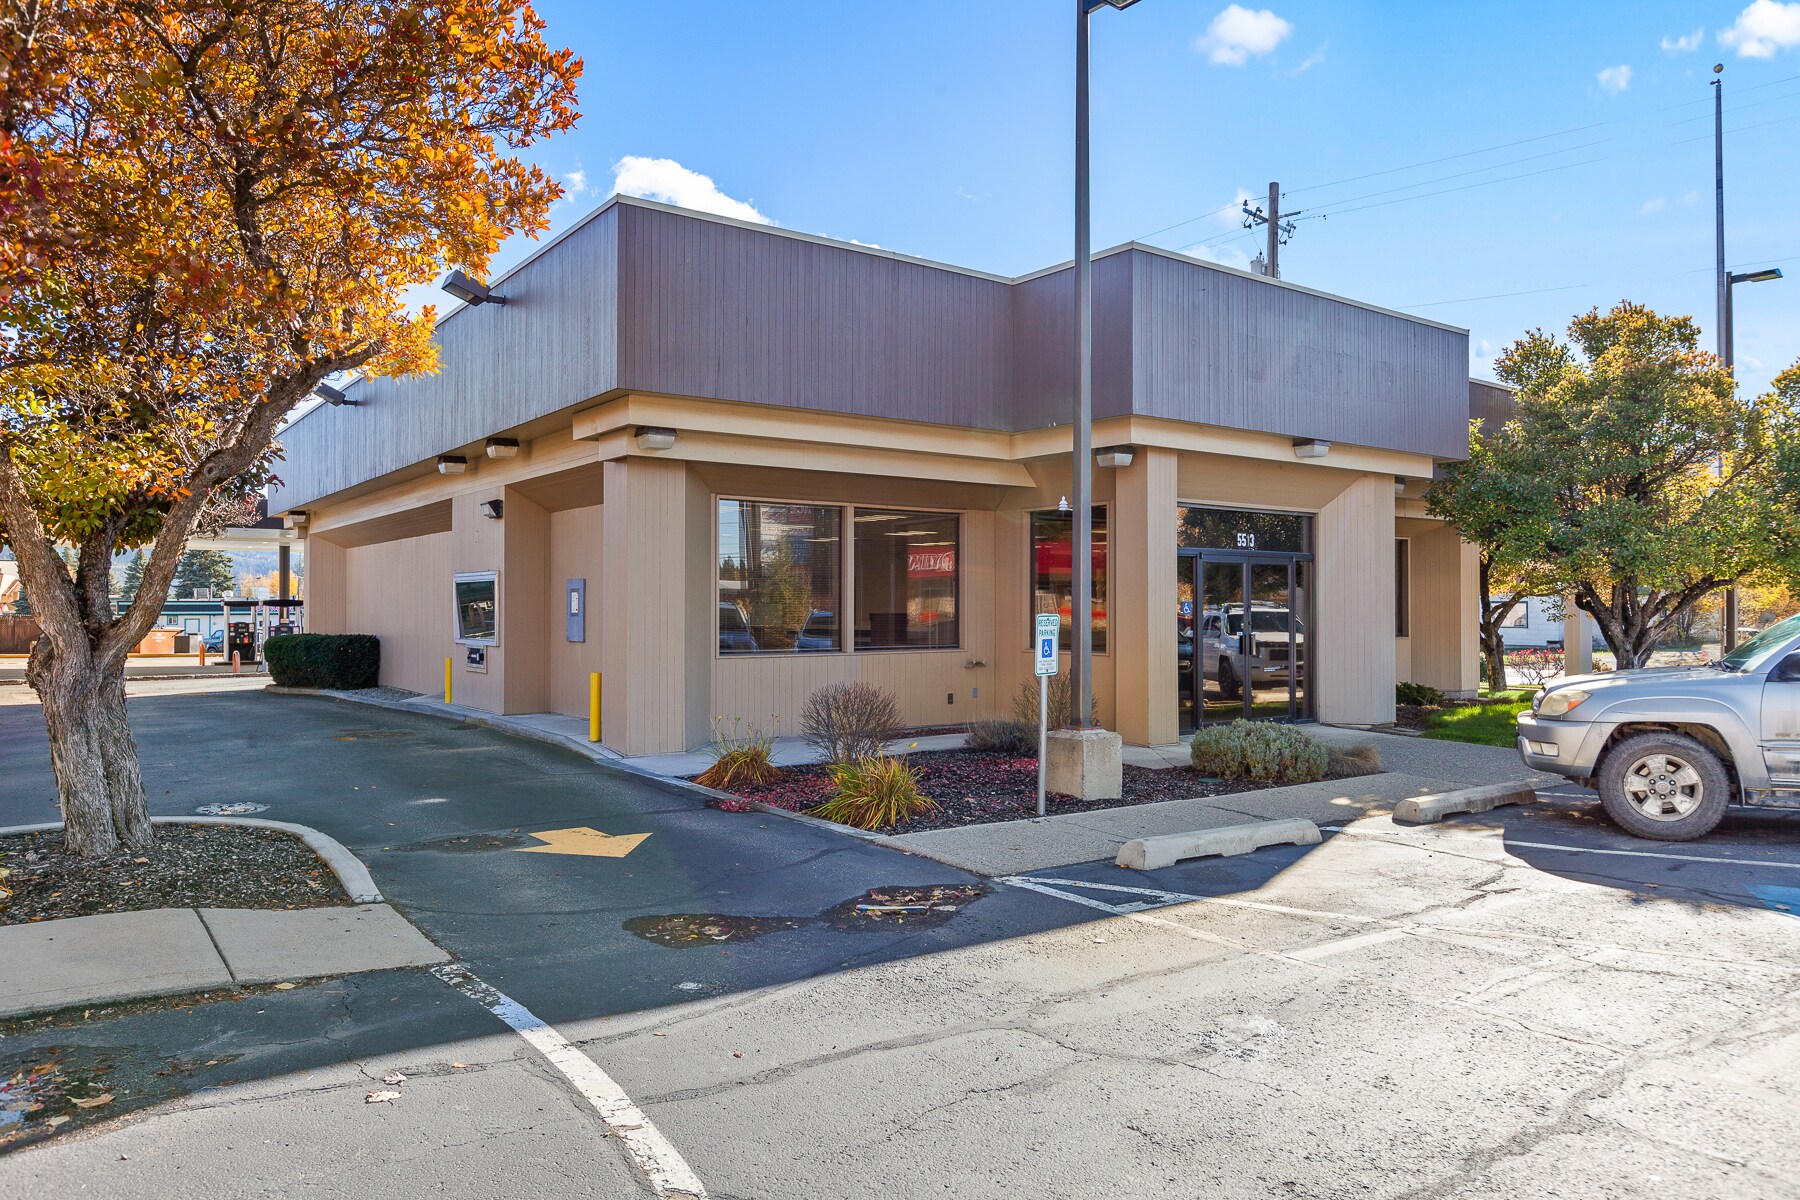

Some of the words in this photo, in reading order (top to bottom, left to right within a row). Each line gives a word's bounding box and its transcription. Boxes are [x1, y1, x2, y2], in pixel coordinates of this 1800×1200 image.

[1237, 532, 1255, 547] 5513
[1038, 618, 1058, 627] RESERVED
[1038, 629, 1056, 637] PARKING
